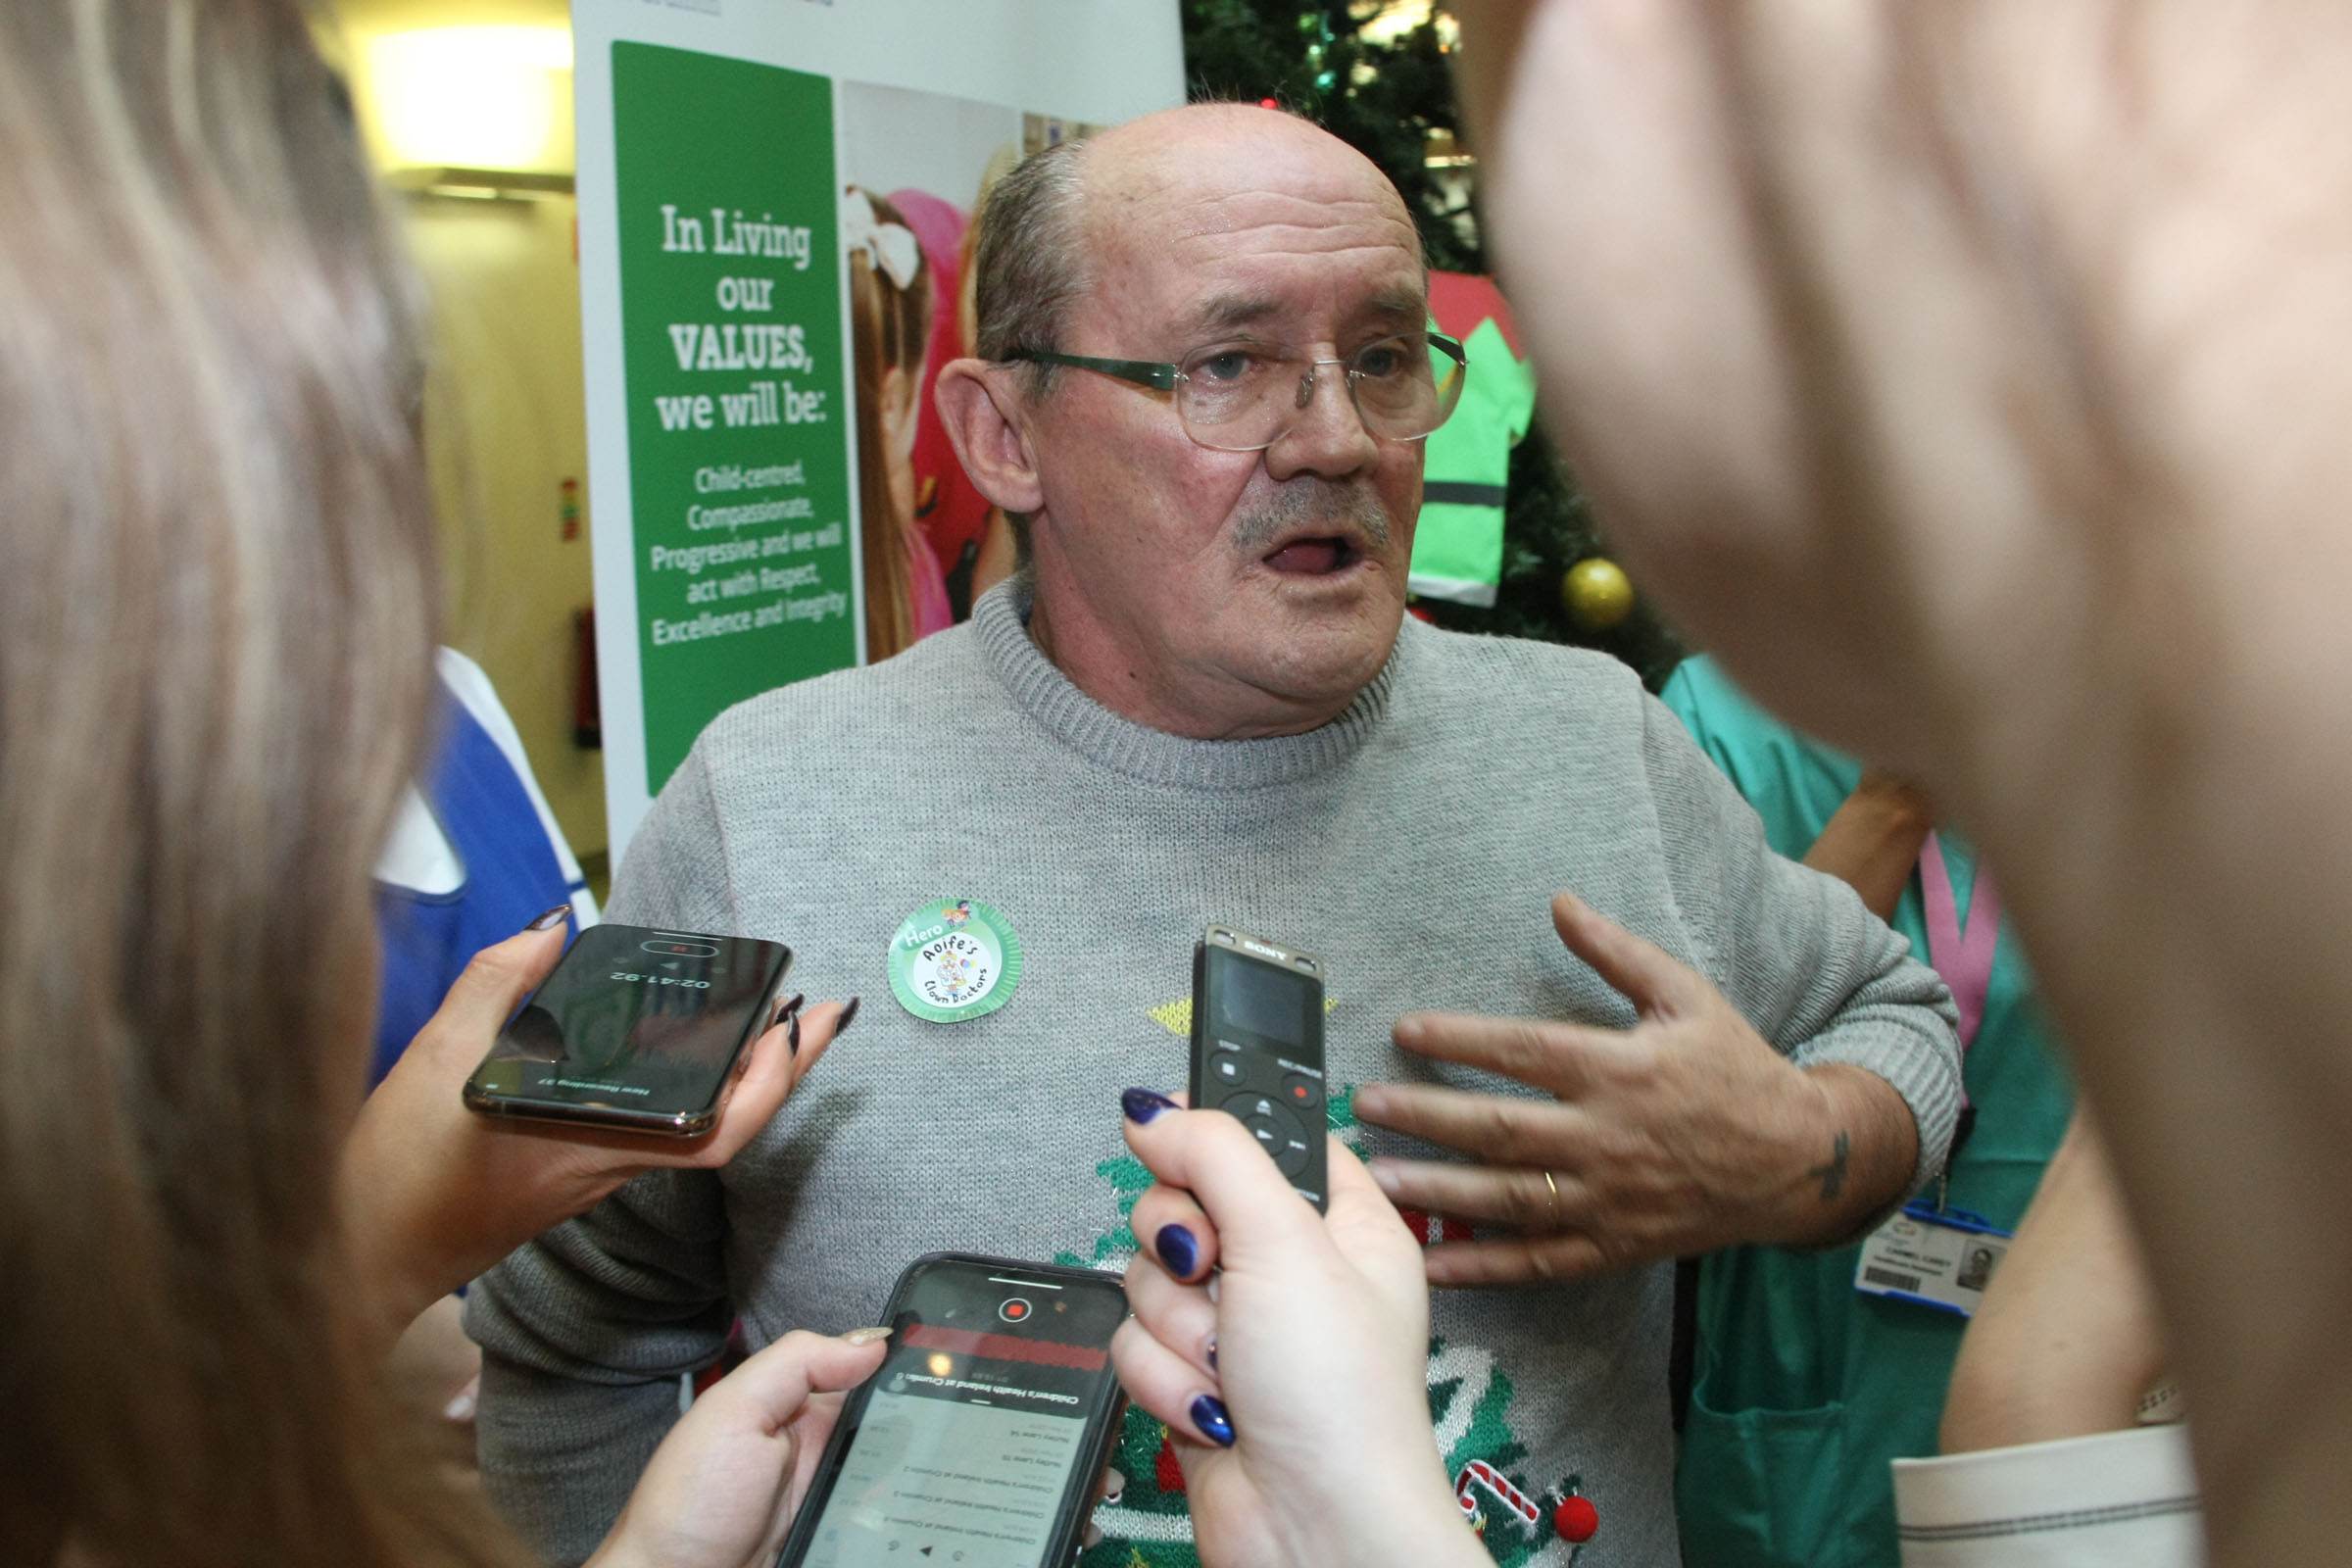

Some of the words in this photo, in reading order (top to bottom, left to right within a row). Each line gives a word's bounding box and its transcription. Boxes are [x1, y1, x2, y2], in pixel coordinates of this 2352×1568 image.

[661, 204, 706, 253] In
[710, 208, 811, 270] Living
[716, 276, 773, 312] our
[667, 323, 813, 375] VALUES,
[655, 394, 713, 431] we
[719, 381, 780, 427] will
[782, 379, 827, 424] be:
[695, 459, 806, 494] Child-centred,
[687, 497, 814, 531] Compassionate,
[651, 536, 759, 574] Progressive
[761, 529, 790, 557] and
[792, 531, 813, 552] we
[815, 521, 842, 547] will
[687, 579, 718, 605] act
[720, 570, 758, 599] with
[760, 564, 820, 594] Respect,
[652, 612, 753, 646] Excellence
[754, 599, 783, 627] and
[786, 591, 847, 623] Integrity
[904, 925, 943, 947] Hero
[923, 936, 978, 961] Aoife's
[1244, 940, 1287, 960] SONY
[610, 972, 710, 989] 02:41.92
[924, 981, 949, 1004] Clown
[952, 968, 987, 1004] Doctors
[557, 1078, 620, 1093] Recording
[621, 1086, 651, 1096] New
[906, 1372, 943, 1386] Crumlin
[956, 1381, 991, 1394] Ireland
[993, 1385, 1027, 1397] Health
[1027, 1390, 1079, 1404] Children's
